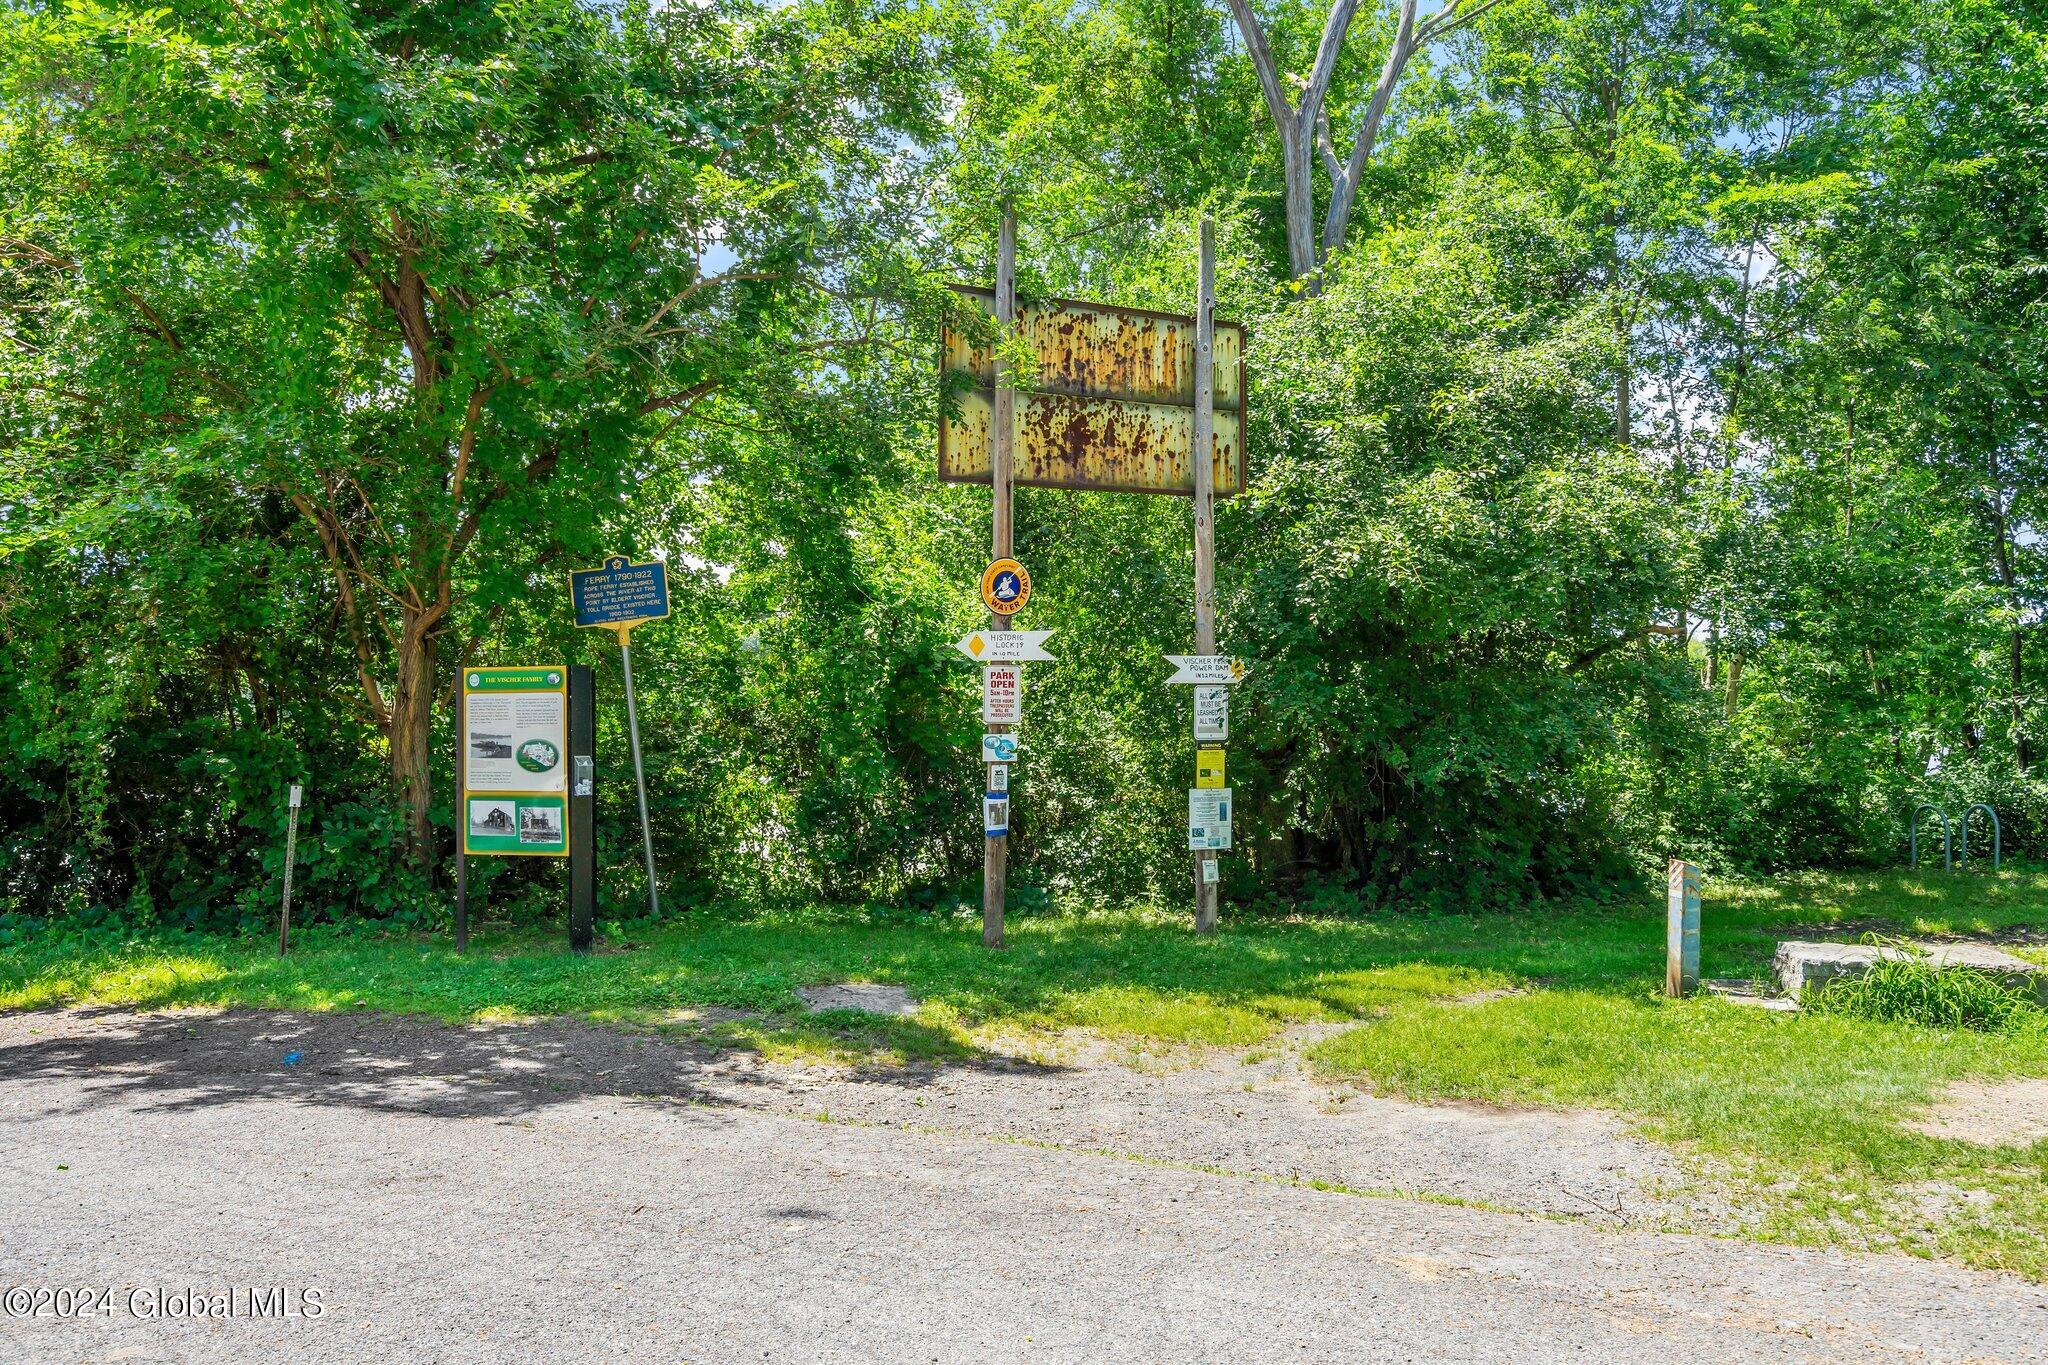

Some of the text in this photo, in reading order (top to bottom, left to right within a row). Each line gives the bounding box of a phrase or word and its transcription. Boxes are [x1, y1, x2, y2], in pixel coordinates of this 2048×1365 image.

[584, 575, 610, 584] FERRY
[620, 580, 654, 588] ESTABLISHED
[992, 598, 1020, 611] WATER
[1020, 572, 1028, 600] TRAIL
